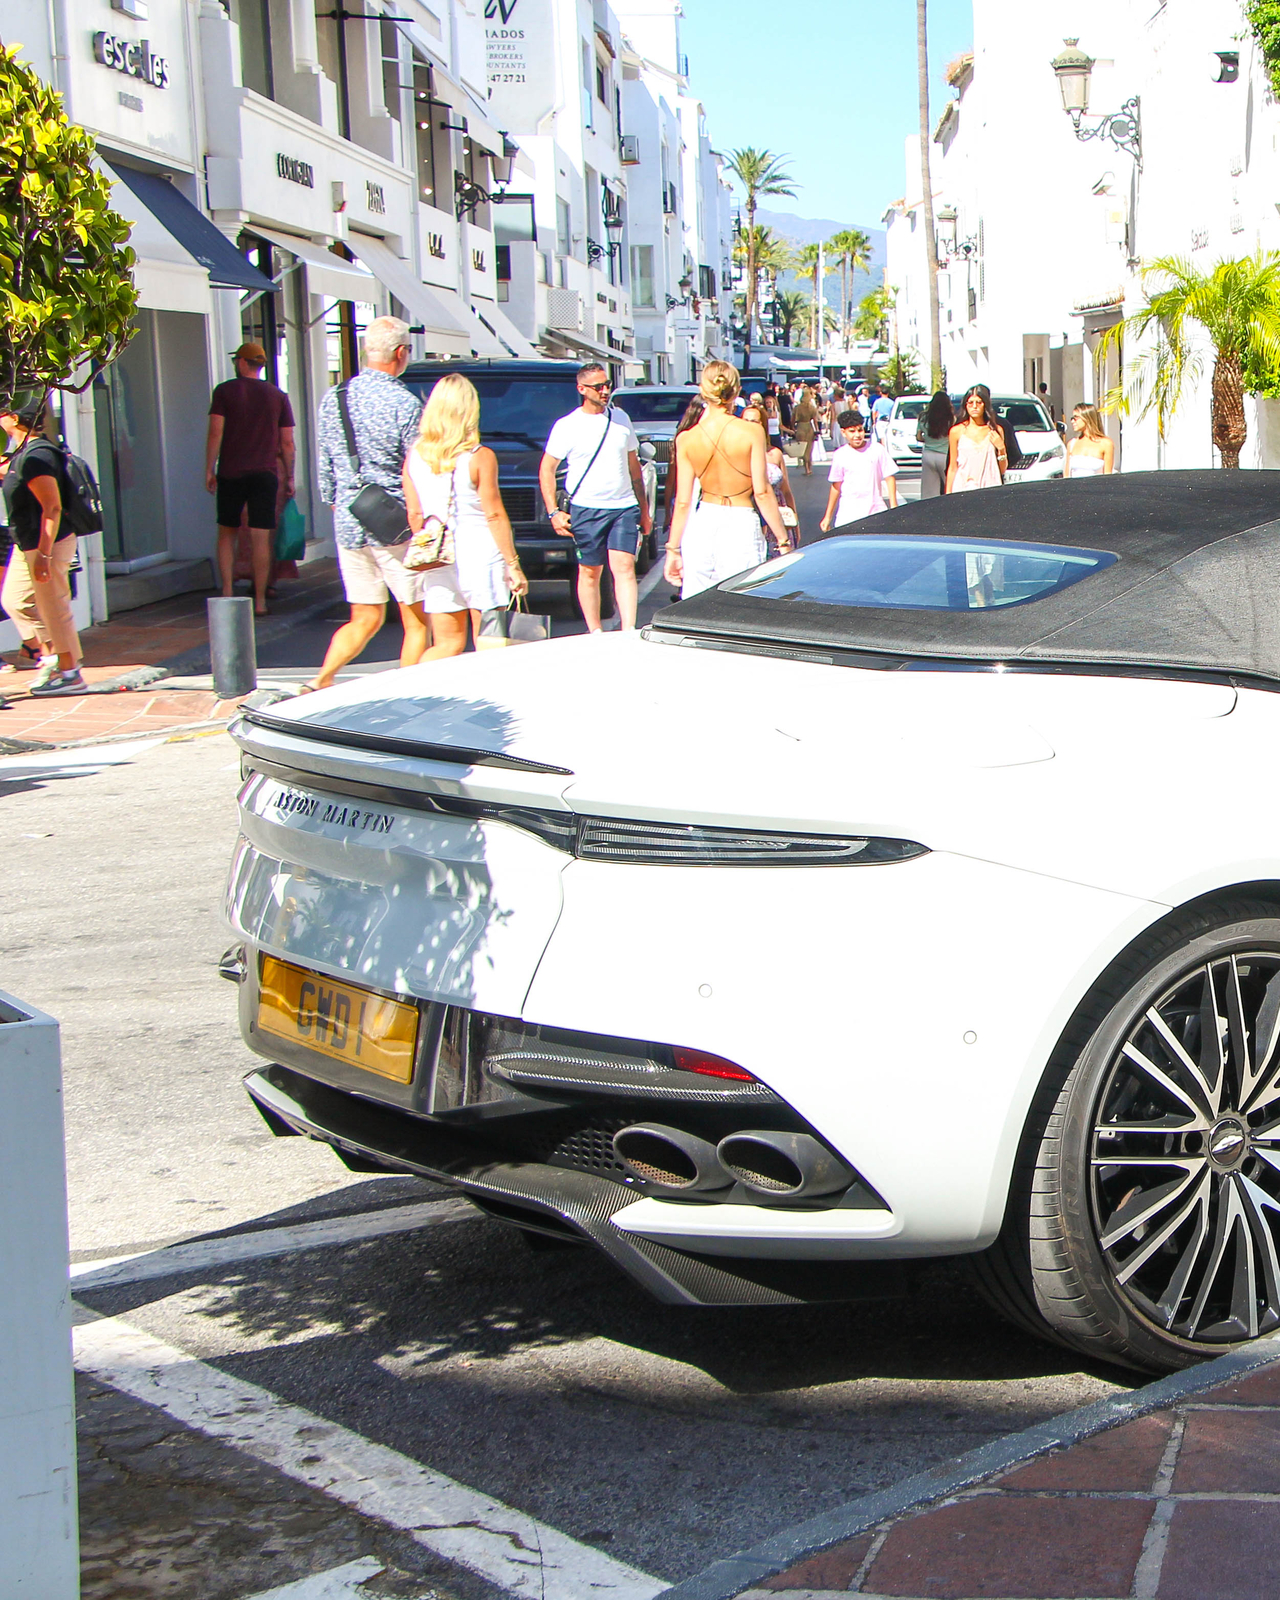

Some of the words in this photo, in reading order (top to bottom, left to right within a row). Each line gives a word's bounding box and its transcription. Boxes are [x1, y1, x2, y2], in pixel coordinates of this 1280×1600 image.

[490, 74, 501, 83] 47
[274, 792, 319, 817] ASTON
[323, 804, 394, 834] MARTIN
